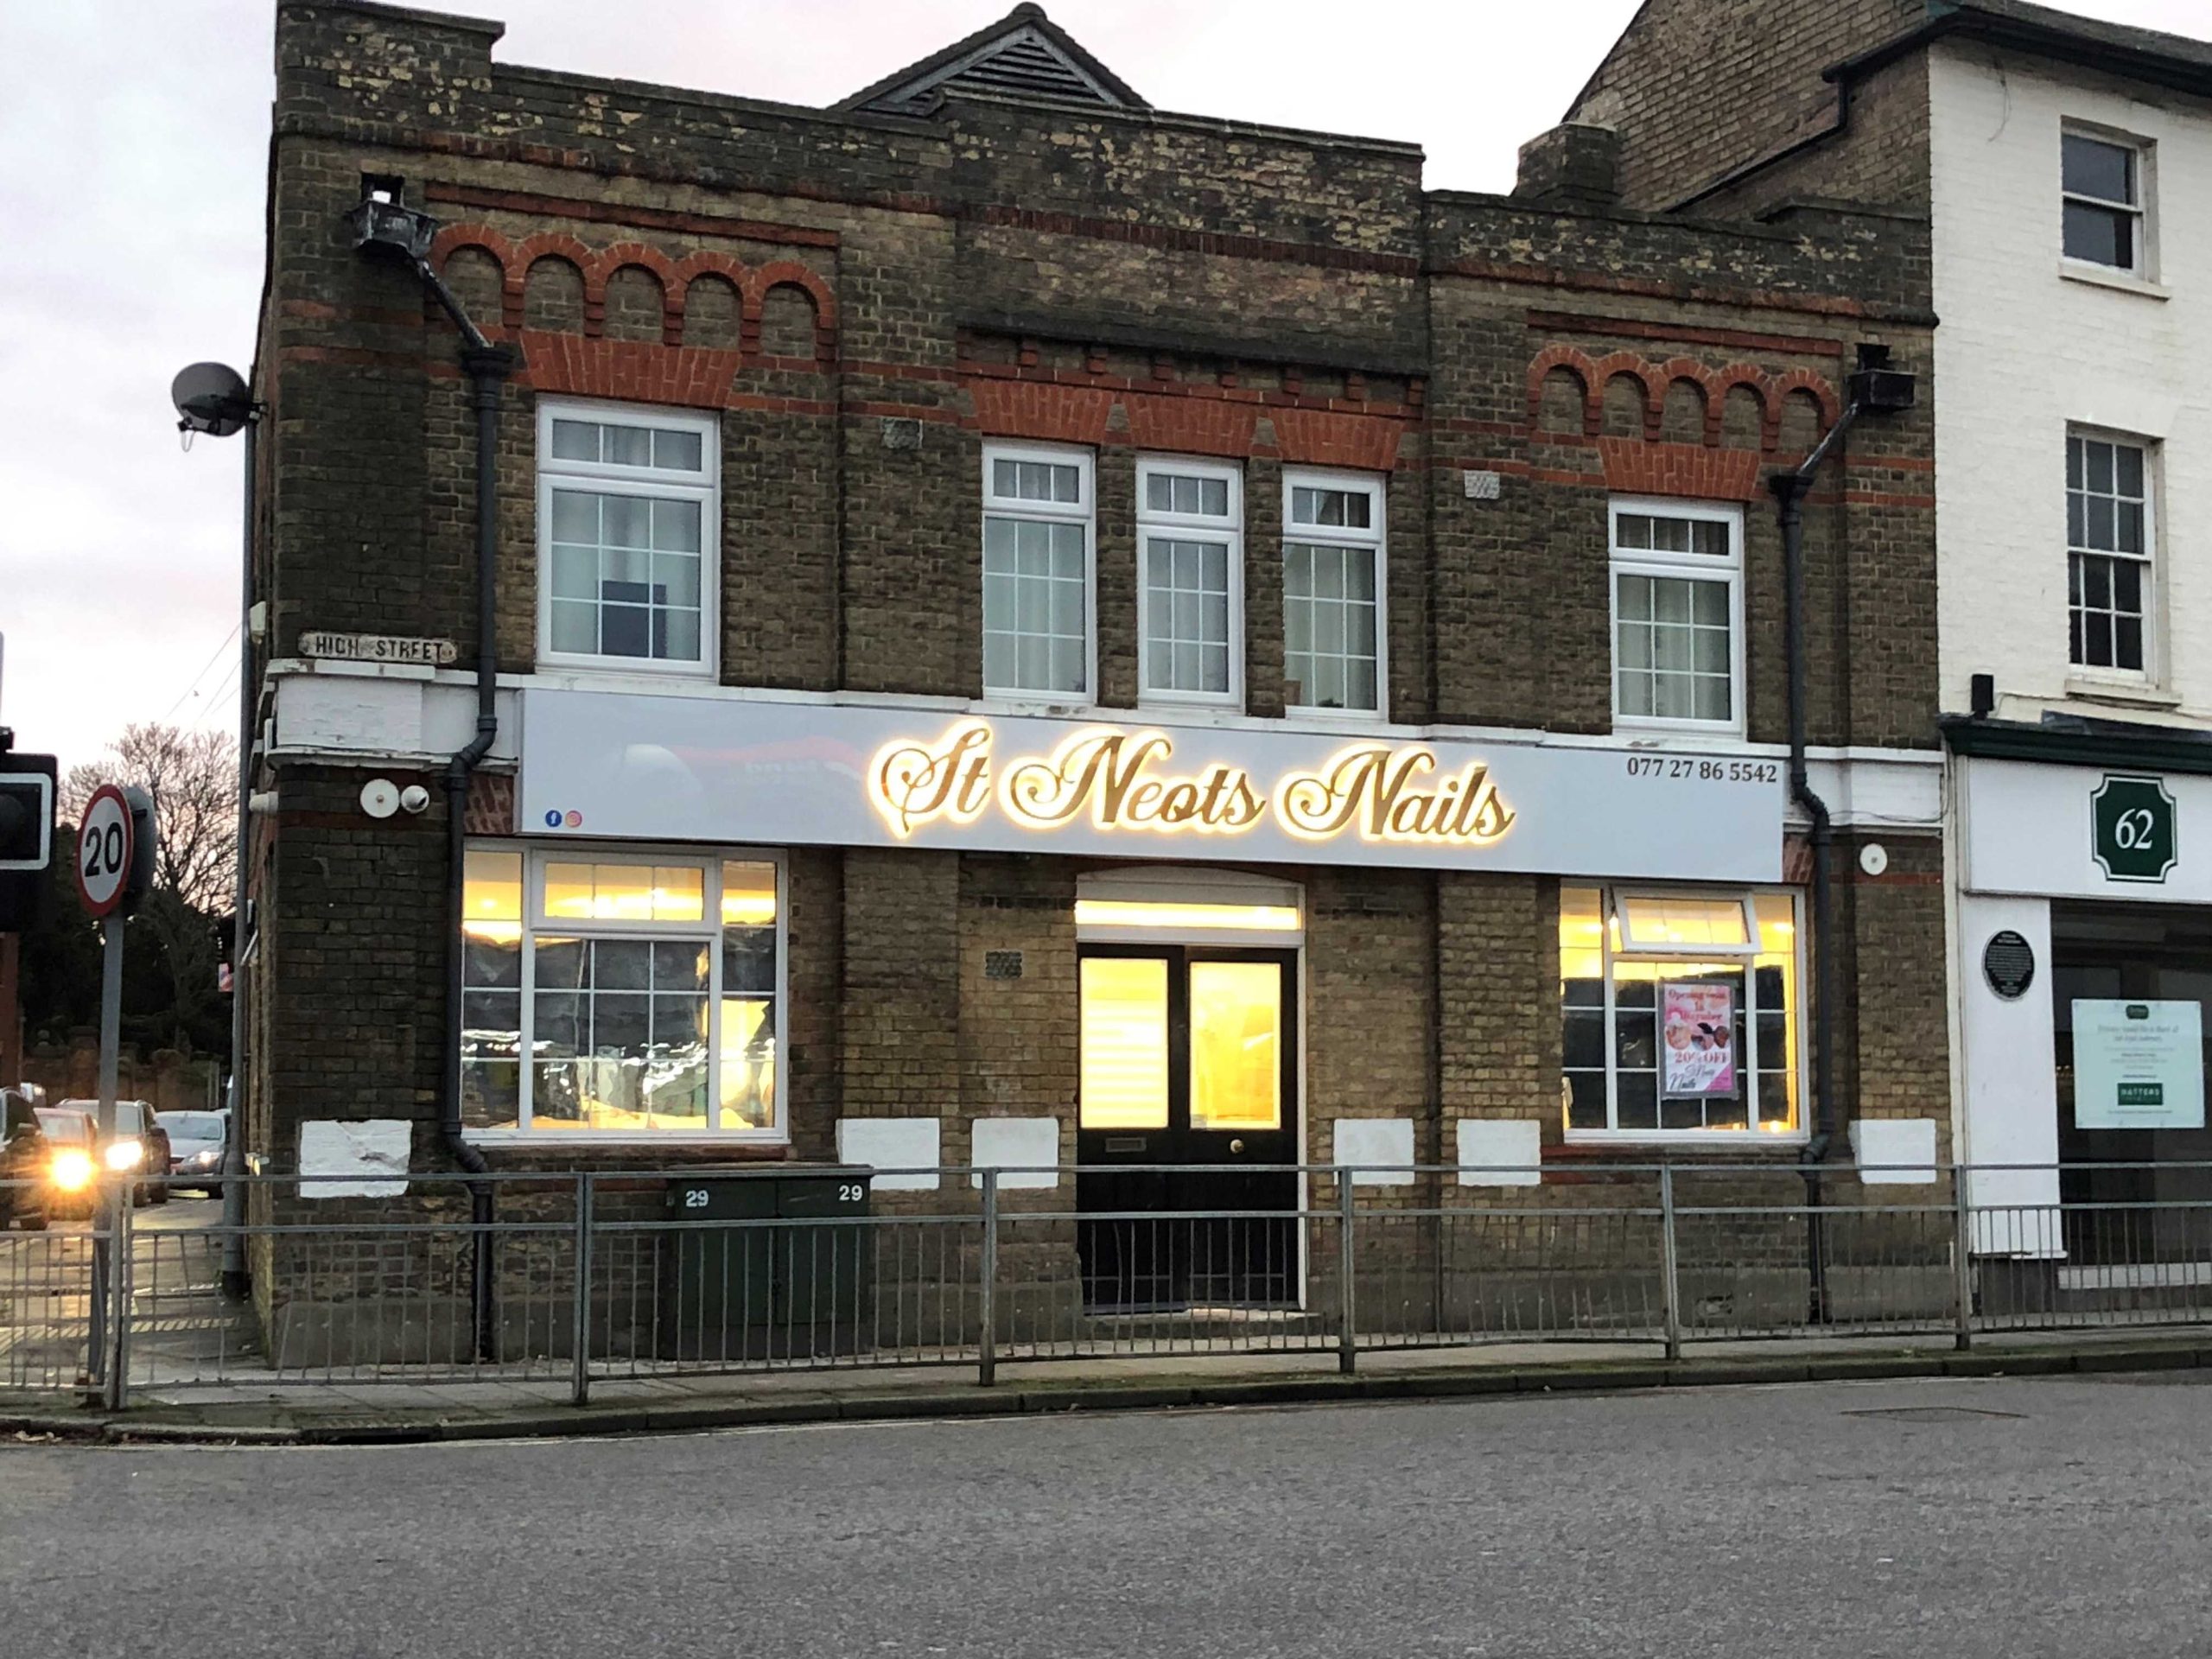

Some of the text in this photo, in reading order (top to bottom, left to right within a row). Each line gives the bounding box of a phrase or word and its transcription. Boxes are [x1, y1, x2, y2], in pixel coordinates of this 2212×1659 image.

[315, 636, 443, 661] HIGH STREET
[880, 727, 1516, 837] St Neots Nails
[1627, 757, 1777, 783] 077 27 86 5542
[2115, 808, 2153, 849] 62
[85, 822, 123, 877] 20
[685, 1190, 709, 1207] 29
[838, 1185, 863, 1201] 29
